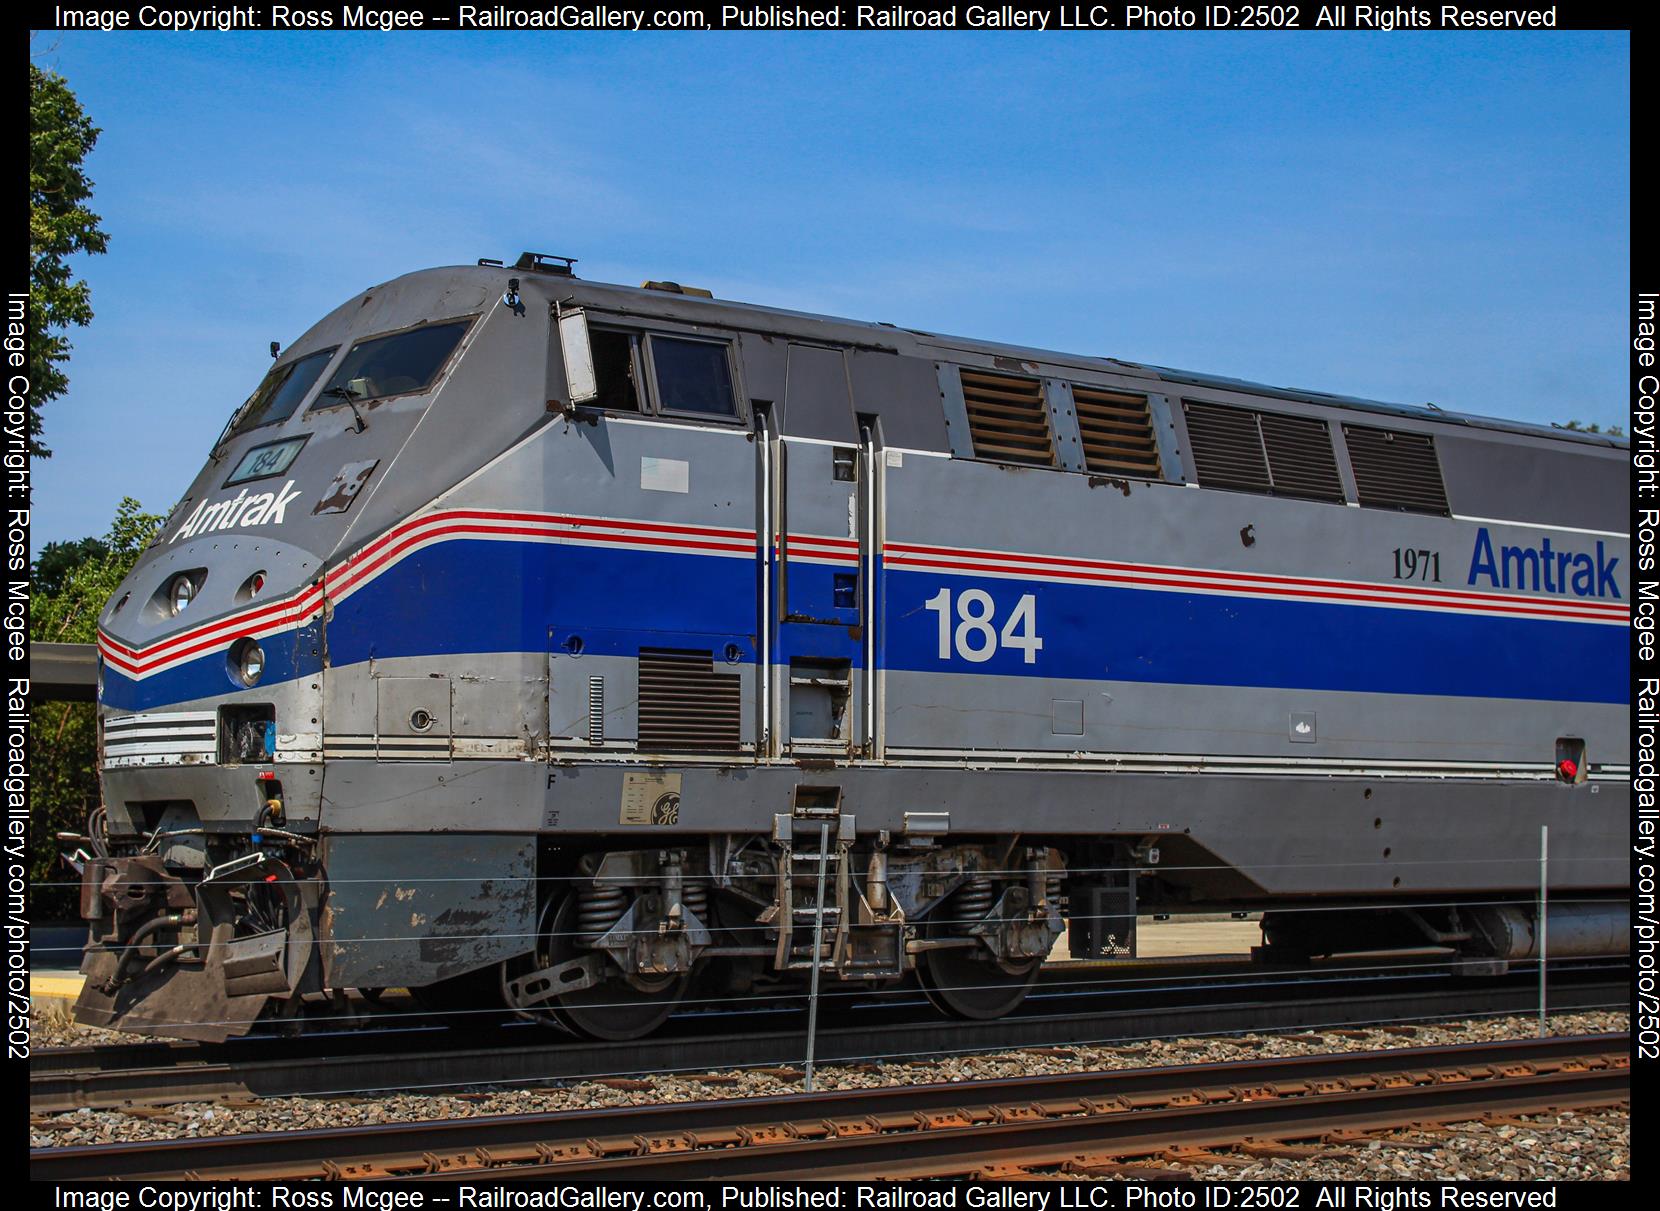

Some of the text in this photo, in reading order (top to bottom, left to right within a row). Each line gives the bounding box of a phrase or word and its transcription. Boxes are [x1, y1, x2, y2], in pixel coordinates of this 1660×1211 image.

[248, 448, 284, 474] 184
[168, 480, 301, 544] Amtrak
[1392, 548, 1441, 583] 1971
[1467, 527, 1621, 598] Amtrak
[925, 588, 1043, 664] 184
[547, 774, 556, 789] F
